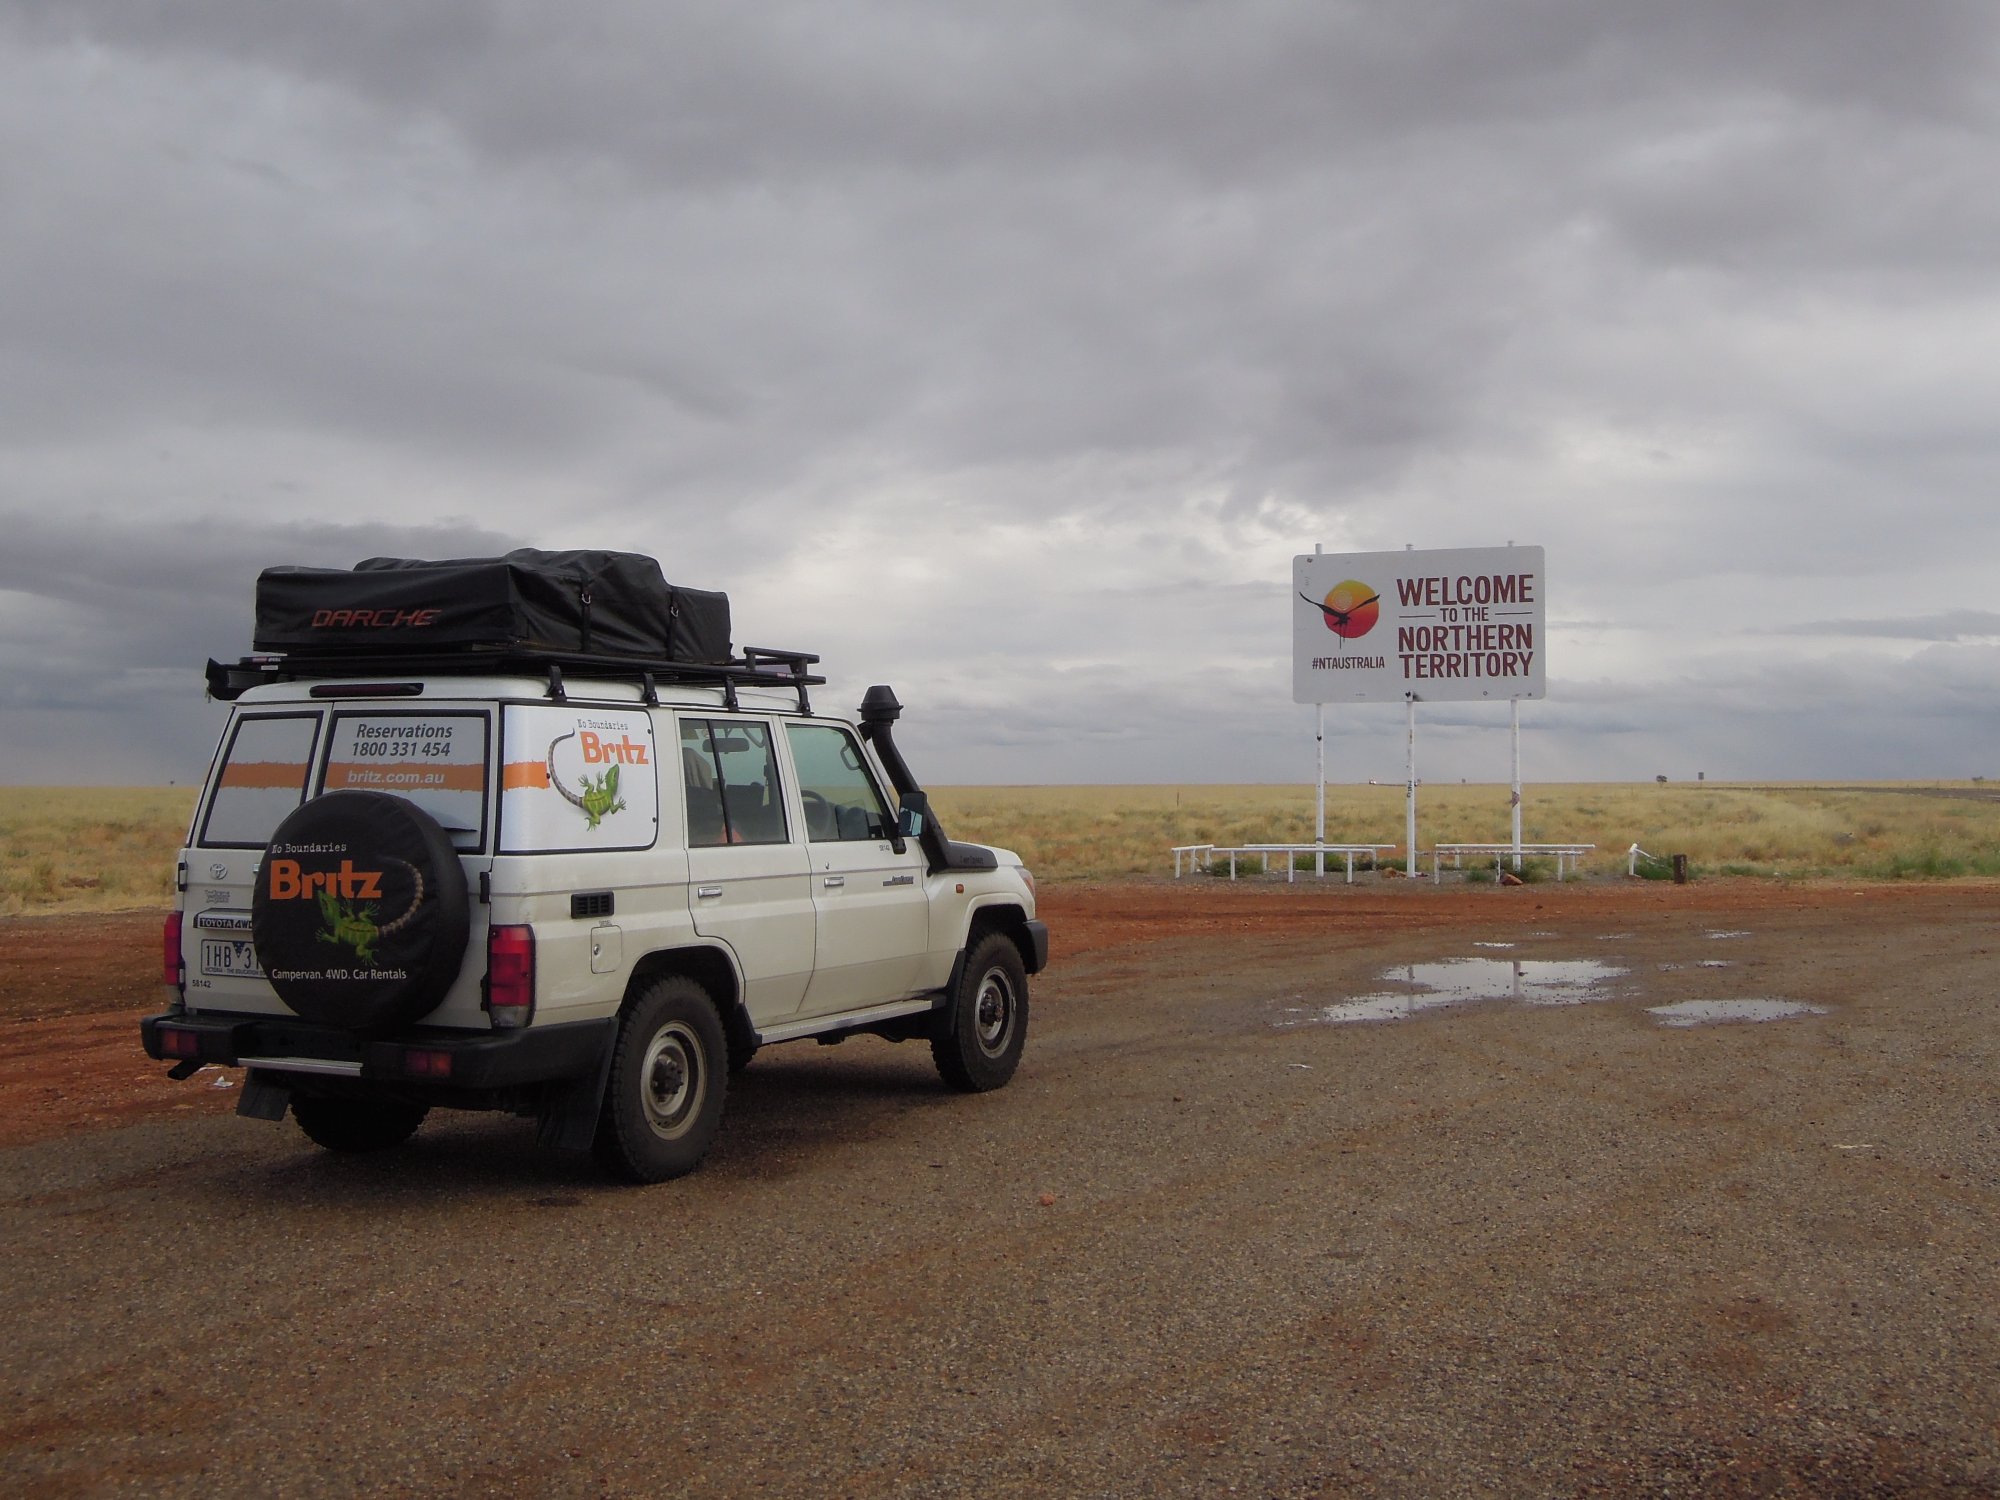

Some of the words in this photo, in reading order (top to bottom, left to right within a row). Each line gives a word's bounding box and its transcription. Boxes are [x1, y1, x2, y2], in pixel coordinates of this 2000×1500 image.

[1396, 574, 1534, 606] WELCOME
[311, 609, 442, 627] DARCHE
[1440, 608, 1457, 622] TO
[1462, 607, 1489, 622] THE
[1398, 624, 1532, 652] NORTHERN
[1312, 656, 1385, 670] #NTAUSTRALIA
[1399, 651, 1534, 679] TERRITORY
[356, 723, 453, 738] Reservations
[588, 720, 629, 730] Boundaries
[352, 742, 387, 756] 1800
[390, 742, 417, 756] 331
[421, 742, 451, 756] 454
[580, 731, 649, 764] Britz
[348, 770, 445, 783] britz.com.au
[272, 844, 283, 854] No
[285, 842, 347, 853] Boundaries
[270, 859, 384, 900] Britz
[202, 919, 233, 928] TOYOTA
[272, 968, 323, 981] Campervan.
[325, 968, 350, 979] 4WD.
[353, 969, 368, 979] Car
[370, 968, 407, 980] Rentals
